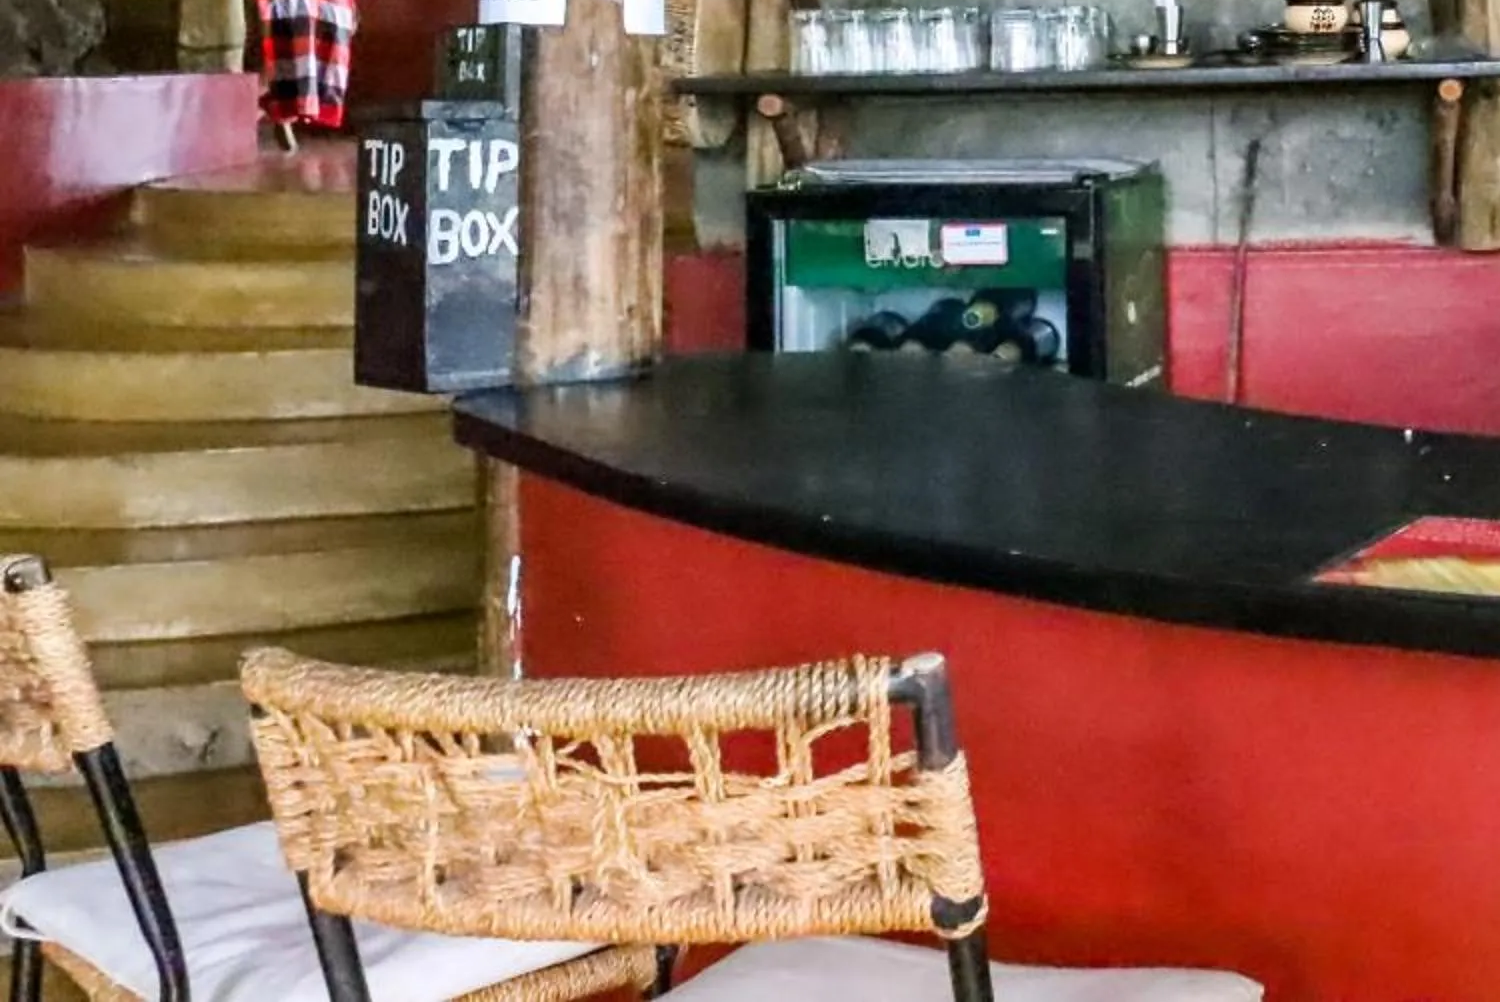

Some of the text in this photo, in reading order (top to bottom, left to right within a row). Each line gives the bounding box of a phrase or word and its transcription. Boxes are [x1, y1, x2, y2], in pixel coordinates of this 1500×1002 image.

[457, 28, 486, 53] TIP
[458, 59, 486, 83] BOX
[364, 138, 405, 186] TIP
[428, 138, 519, 194] TIP
[367, 190, 409, 247] BOX
[428, 206, 520, 265] BOX
